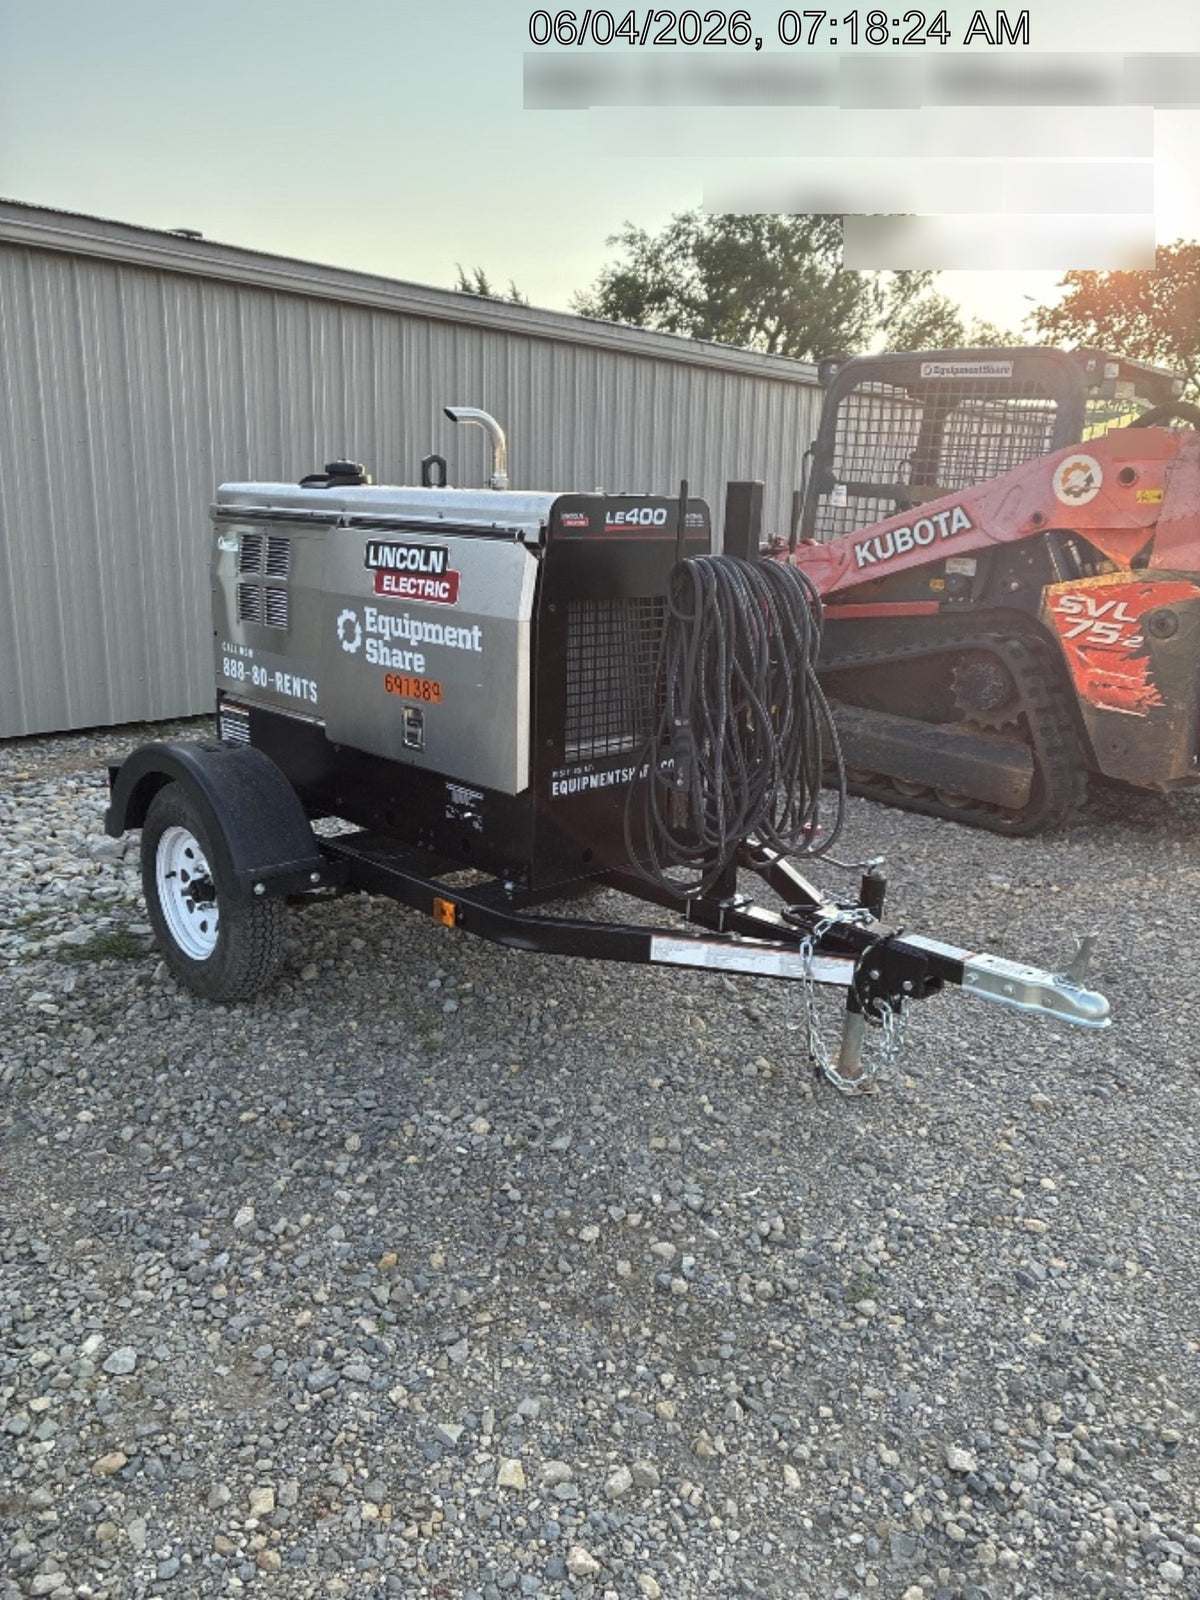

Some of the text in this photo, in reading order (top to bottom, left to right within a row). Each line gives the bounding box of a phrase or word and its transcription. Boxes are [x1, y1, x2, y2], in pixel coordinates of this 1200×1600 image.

[605, 507, 667, 526] LE400
[854, 506, 972, 568] KUBOTA
[368, 545, 443, 574] LINCOLN
[382, 575, 450, 599] ELECTRIC
[1053, 595, 1136, 623] SVL
[364, 606, 482, 652] Equipment
[365, 638, 426, 674] Share
[223, 656, 318, 705] 888-80-RENTS
[384, 673, 441, 701] 691389
